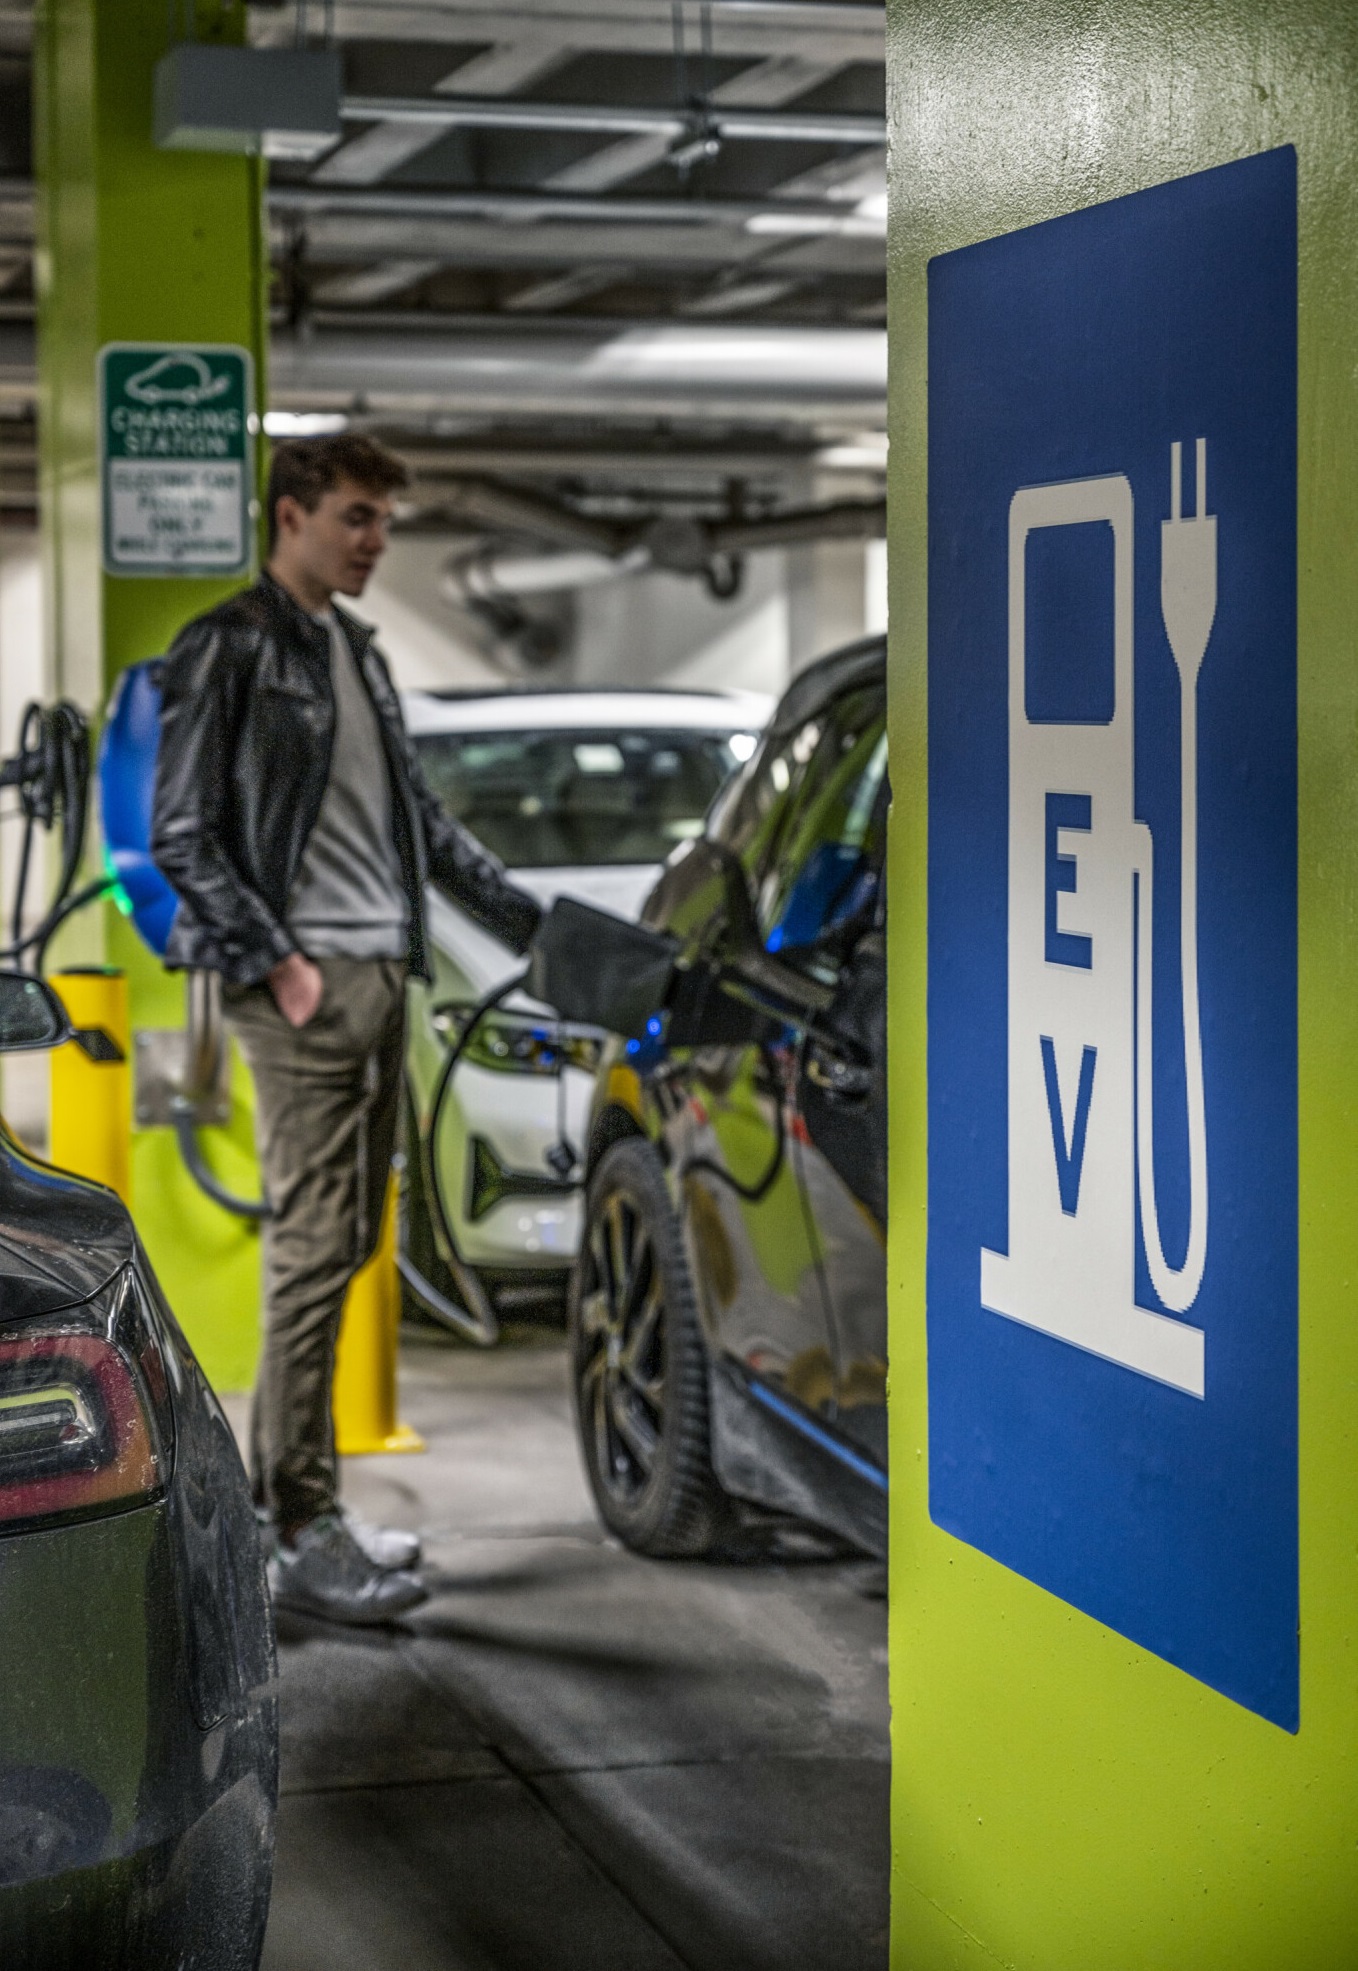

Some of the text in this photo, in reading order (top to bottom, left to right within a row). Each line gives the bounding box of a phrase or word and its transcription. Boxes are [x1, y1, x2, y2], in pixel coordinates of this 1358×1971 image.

[111, 406, 242, 433] CHARGING
[123, 430, 229, 455] STATION
[1039, 790, 1098, 1218] EV
